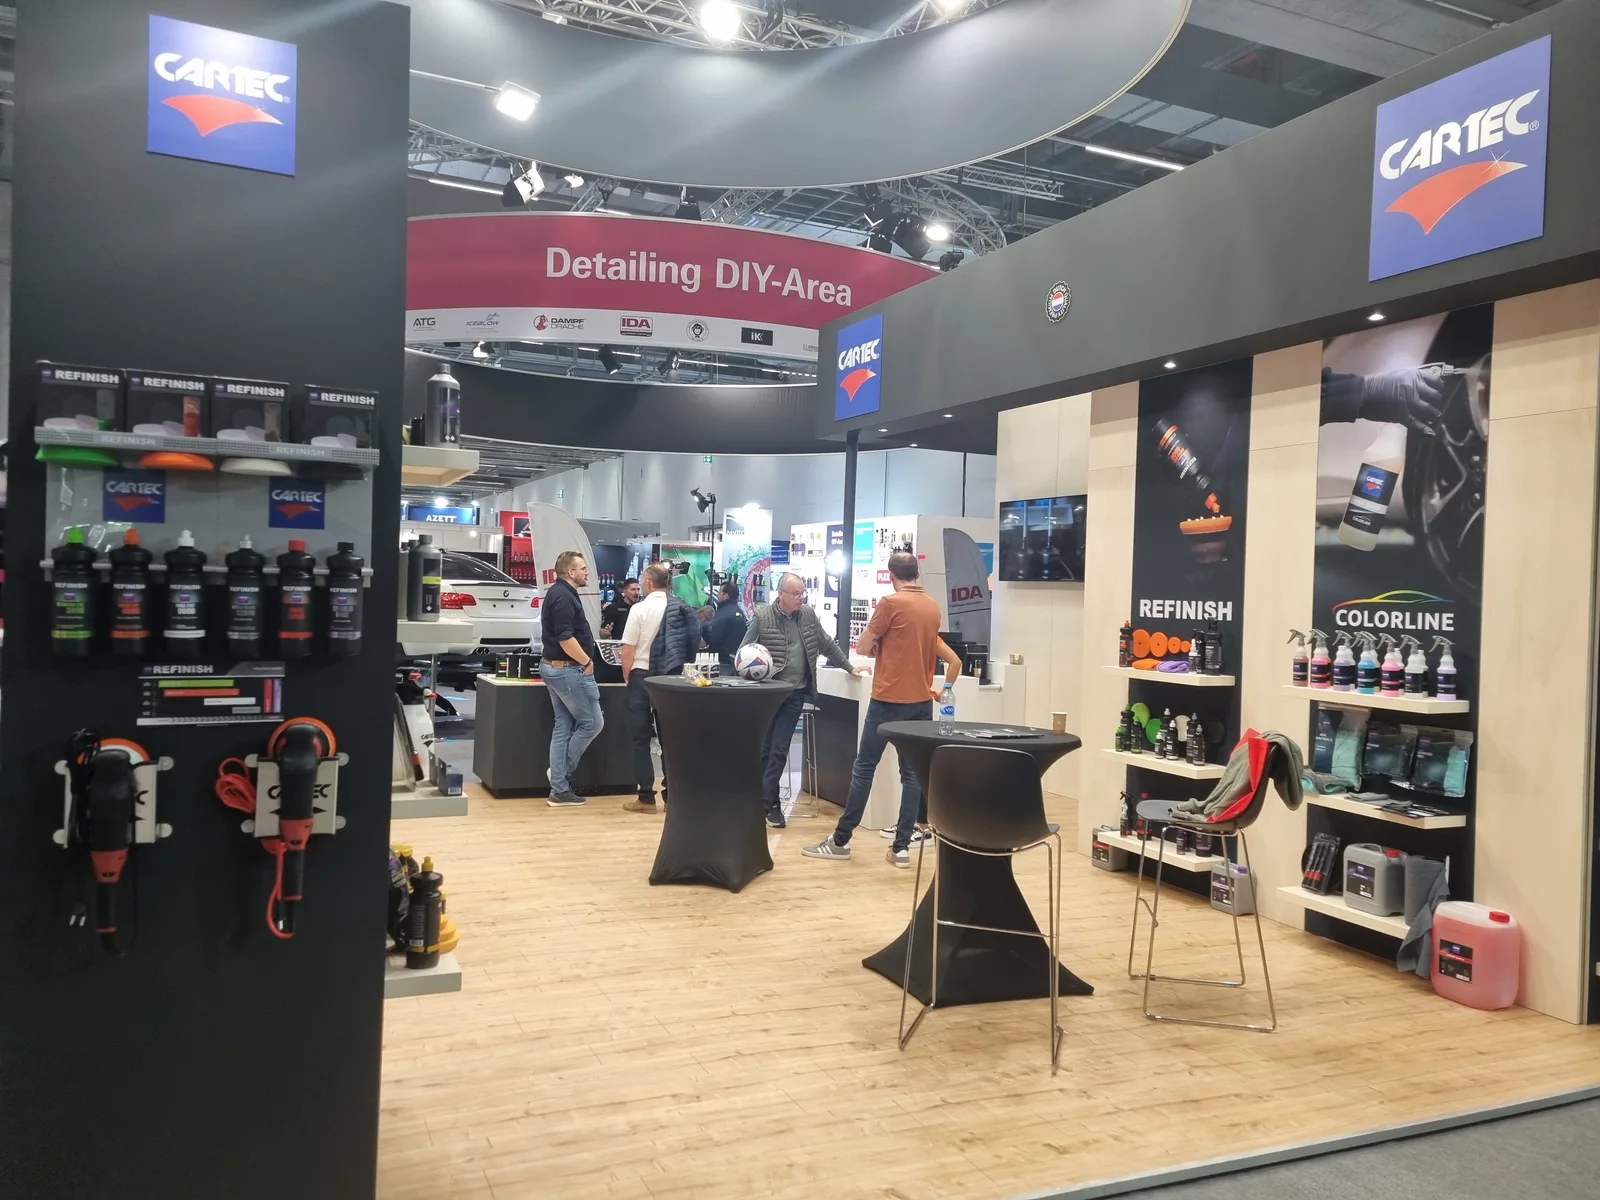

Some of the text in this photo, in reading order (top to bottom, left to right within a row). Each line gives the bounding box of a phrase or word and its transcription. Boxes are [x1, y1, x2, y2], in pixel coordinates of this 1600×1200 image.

[154, 52, 290, 103] CARTEC
[1379, 88, 1540, 180] CARTEC
[546, 246, 853, 307] Detailing DIY-Area
[412, 317, 436, 327] ATG
[550, 323, 584, 331] DRACHE
[622, 317, 651, 329] IDA
[838, 338, 880, 371] CARTEC
[54, 369, 120, 385] REFINISH
[143, 376, 205, 392] REFINISH
[226, 383, 286, 398] REFINISH
[320, 392, 376, 406] REFINISH
[100, 434, 157, 446] REFINISH
[275, 446, 326, 457] REFINISH
[105, 480, 164, 495] CARTEC
[271, 489, 323, 503] CARTEC
[425, 514, 457, 523] AZETT
[951, 584, 984, 603] IDA
[1138, 598, 1233, 622] REFINISH
[1334, 608, 1455, 632] COLORLINE
[152, 664, 214, 674] REFINISH
